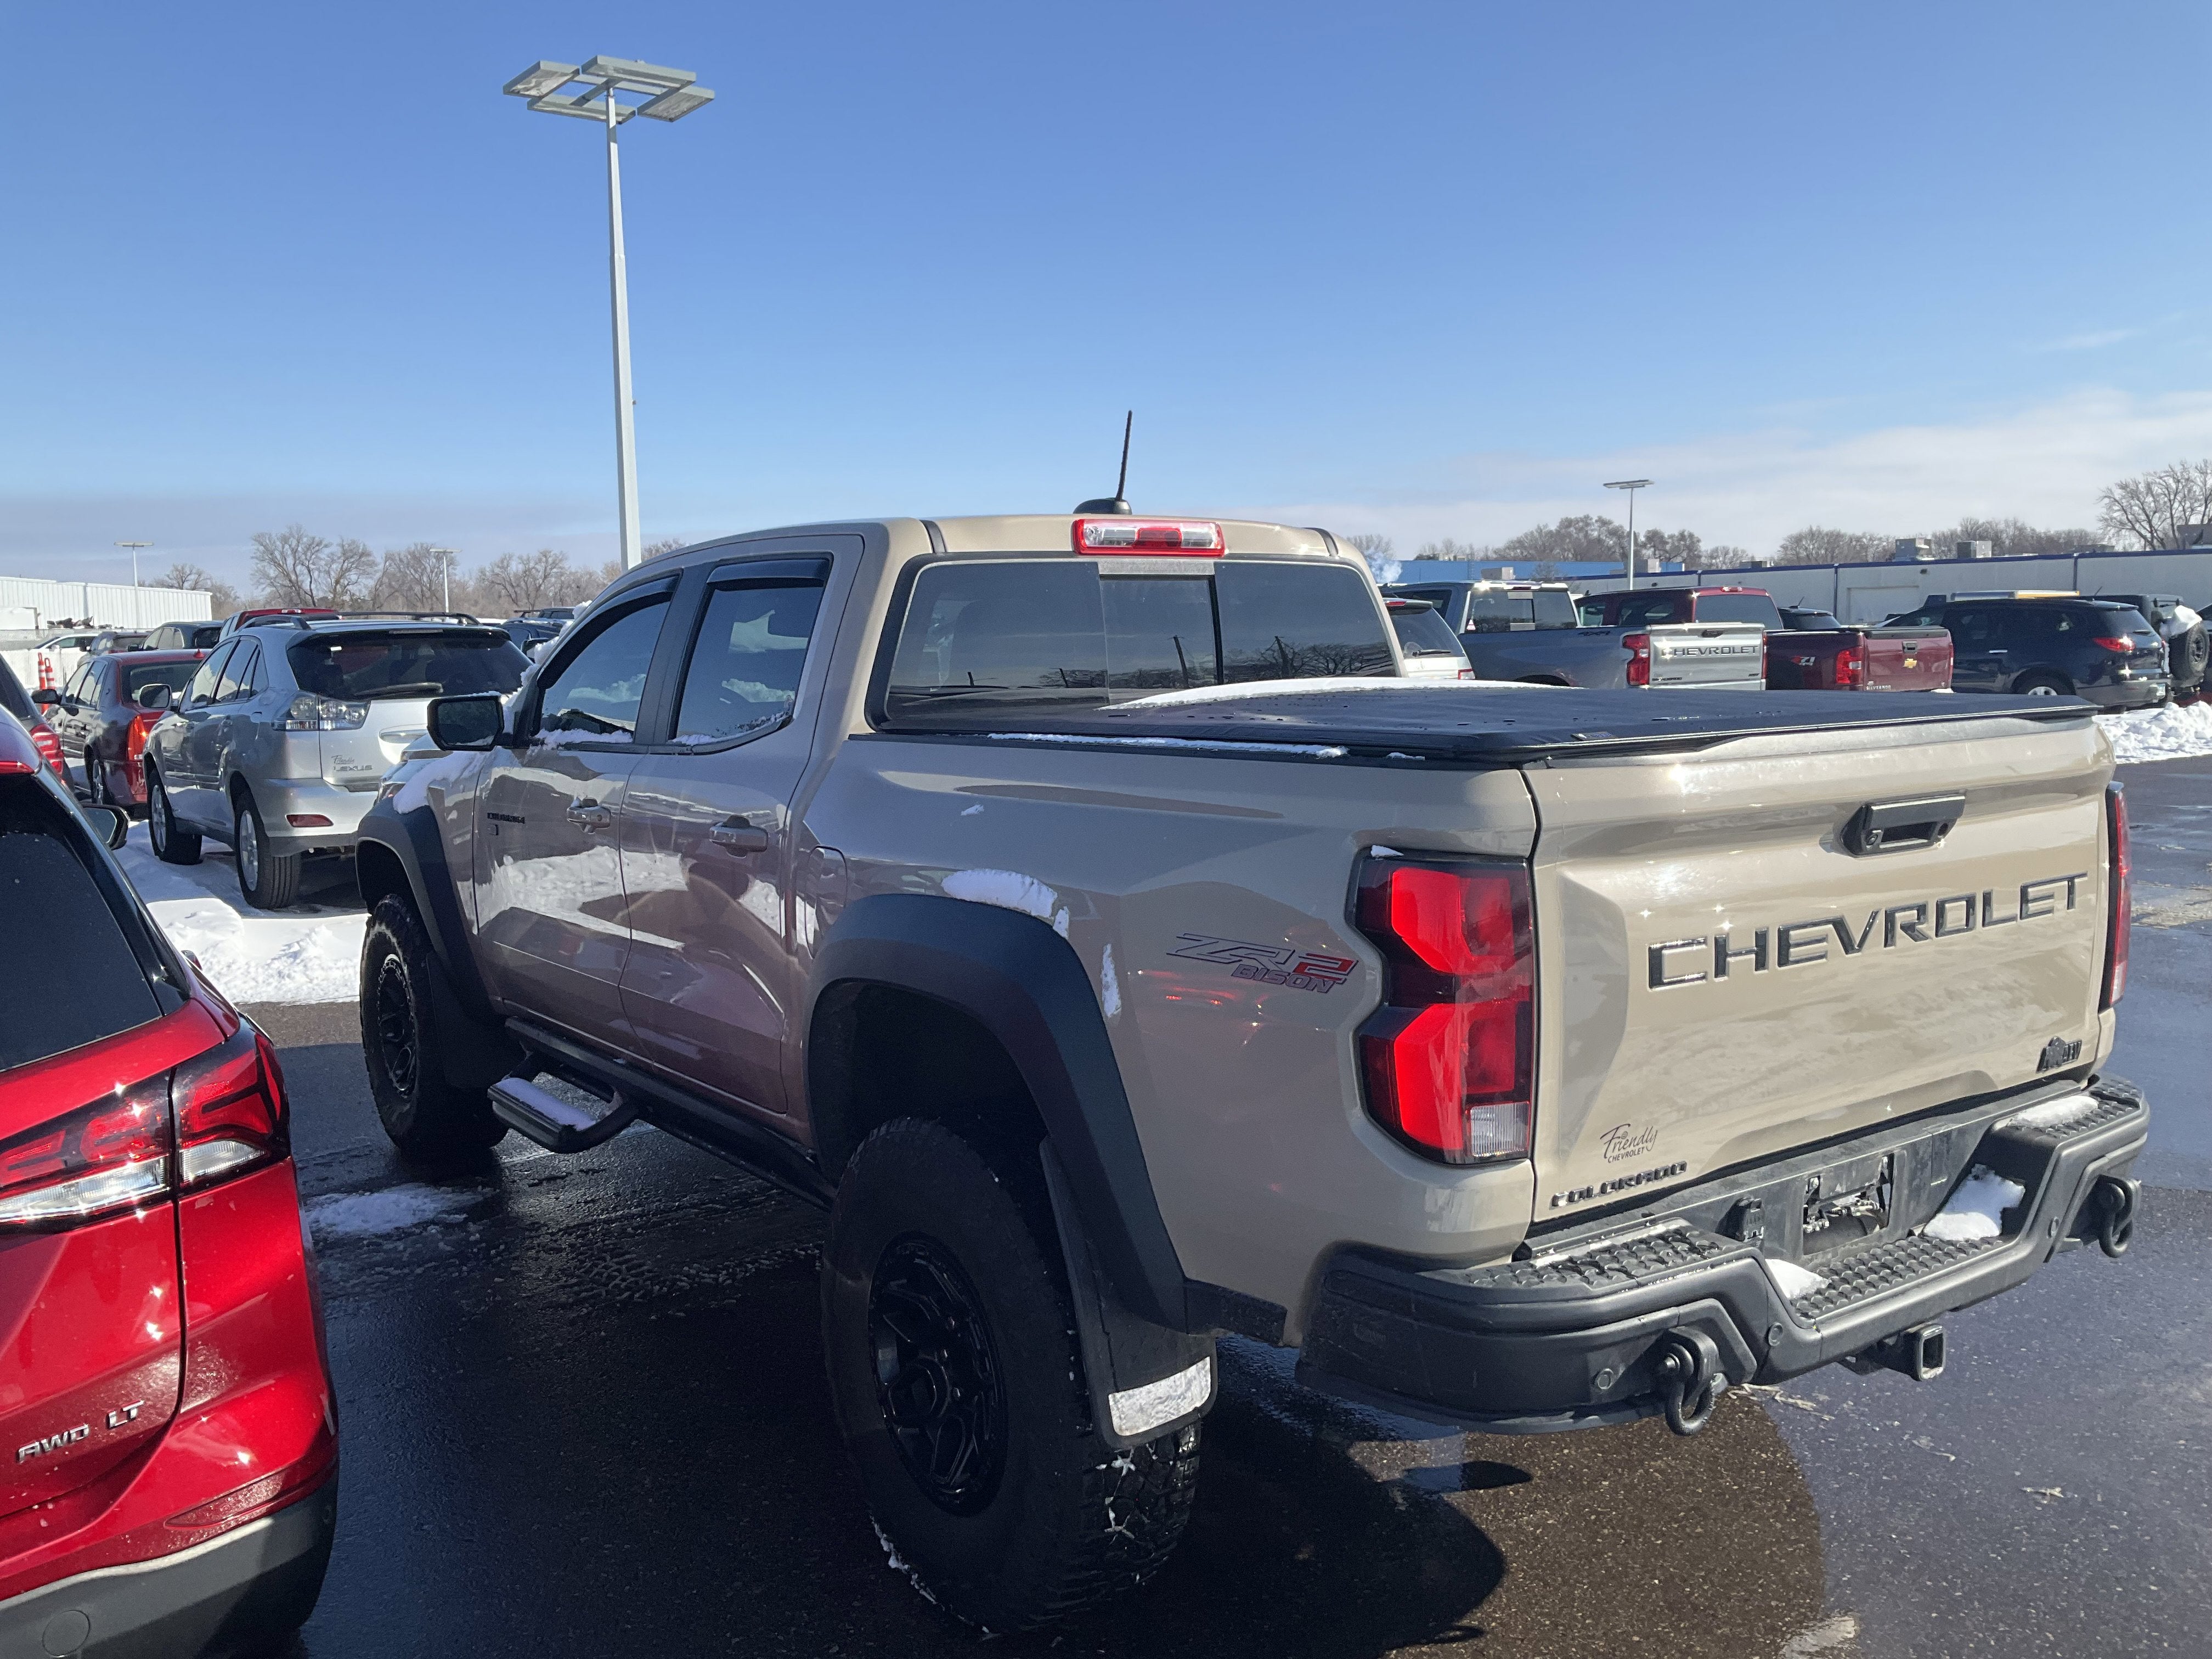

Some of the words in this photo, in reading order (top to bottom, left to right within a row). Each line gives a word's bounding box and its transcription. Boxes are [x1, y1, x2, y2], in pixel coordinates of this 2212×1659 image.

[1661, 646, 1758, 657] CHEVROLET
[1647, 871, 2088, 990] CHEVROLET
[1166, 933, 1359, 985] ZR2
[1231, 963, 1337, 994] BISON
[1599, 1123, 1658, 1159] Friendly
[1607, 1147, 1645, 1163] CHEVROLET
[1550, 1161, 1688, 1209] COLORADO
[15, 1423, 90, 1465] AWD
[106, 1399, 145, 1429] LT
